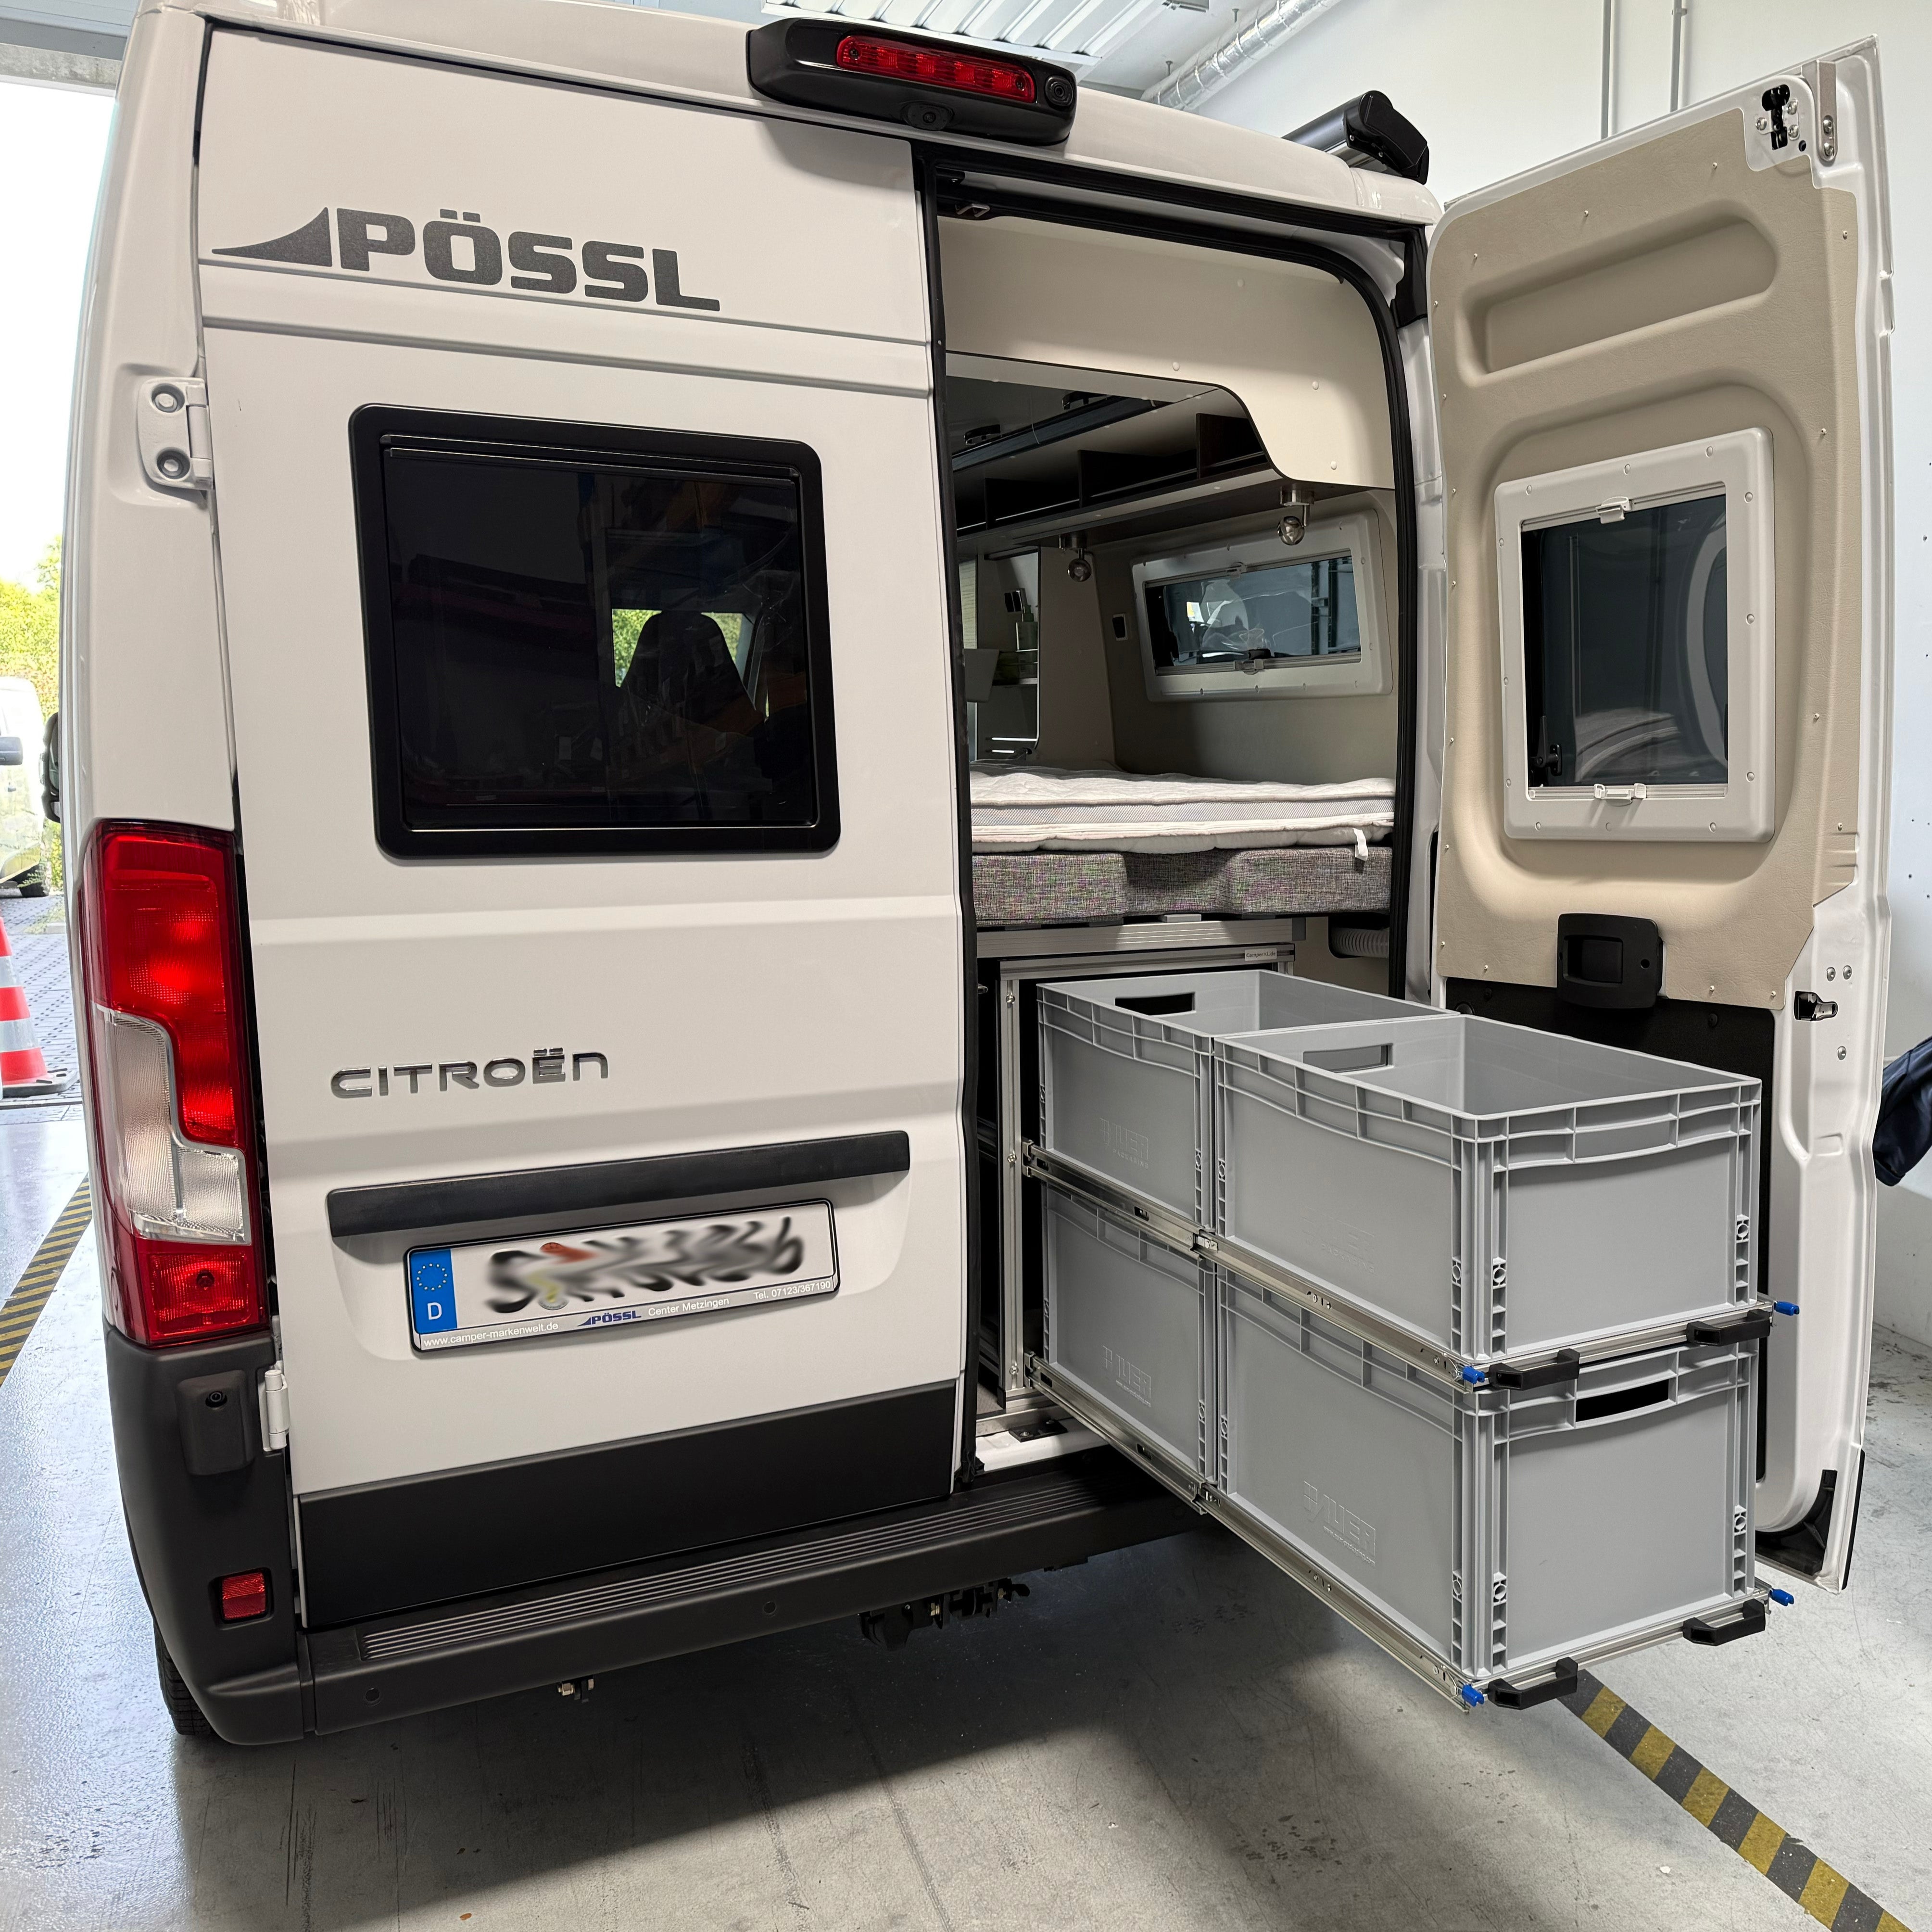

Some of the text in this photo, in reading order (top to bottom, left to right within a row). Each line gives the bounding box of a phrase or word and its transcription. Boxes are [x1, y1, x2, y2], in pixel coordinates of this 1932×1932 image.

[336, 208, 720, 311] PÖSSL
[427, 1302, 442, 1320] D
[591, 1280, 831, 1325] PÖSSL Center Metzingen Tel. 07123/367190
[424, 1322, 558, 1347] www.camper-markenwelt.de
